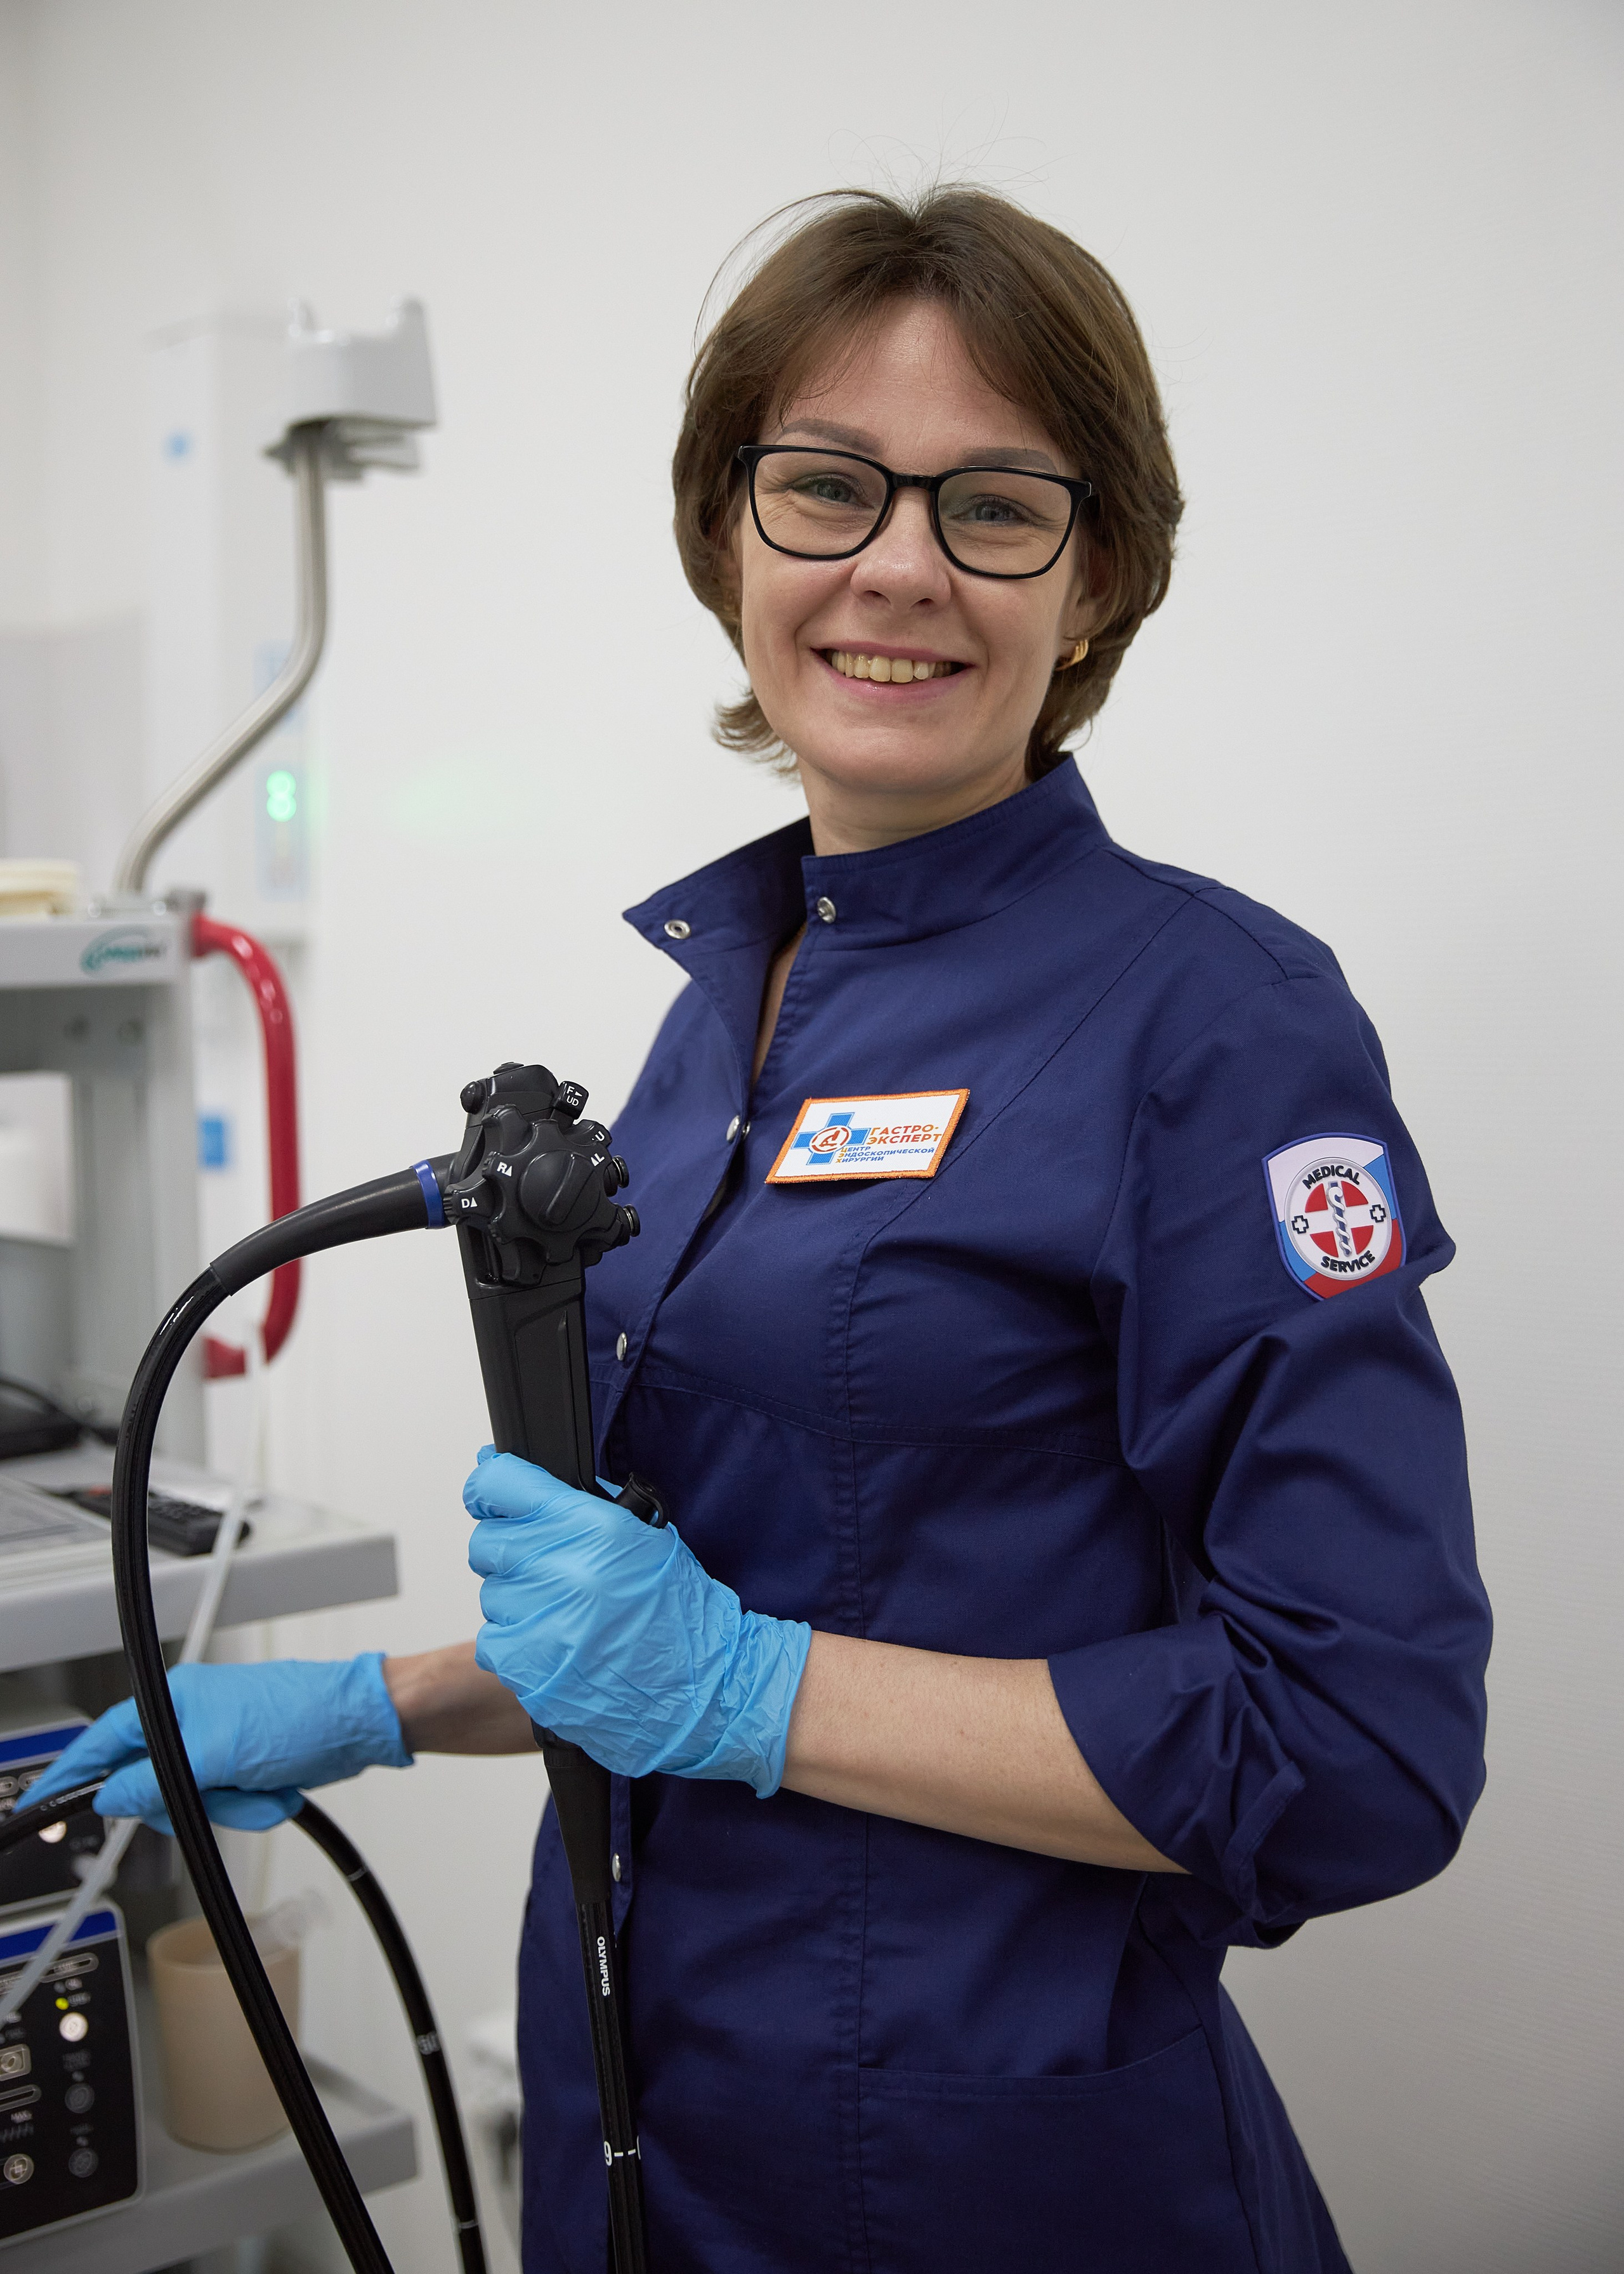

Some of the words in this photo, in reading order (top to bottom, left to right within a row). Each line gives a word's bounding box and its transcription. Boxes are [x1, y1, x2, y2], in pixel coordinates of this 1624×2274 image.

[566, 1085, 575, 1094] F
[566, 1095, 579, 1106] UD
[870, 1124, 939, 1135] ГАСТРО-
[594, 1130, 605, 1142] U
[866, 1134, 943, 1145] ЭКСПЕРТ
[594, 1153, 605, 1163] L
[838, 1147, 935, 1158] ЭНДОСКОПИЧЕСКОЙ
[835, 1156, 884, 1164] ХИРУРГИИ
[496, 1161, 508, 1173] R
[1302, 1165, 1360, 1190] MEDICAL
[461, 1198, 470, 1208] D
[1321, 1250, 1375, 1273] SERVICE
[597, 1936, 611, 1997] OLYMPUS
